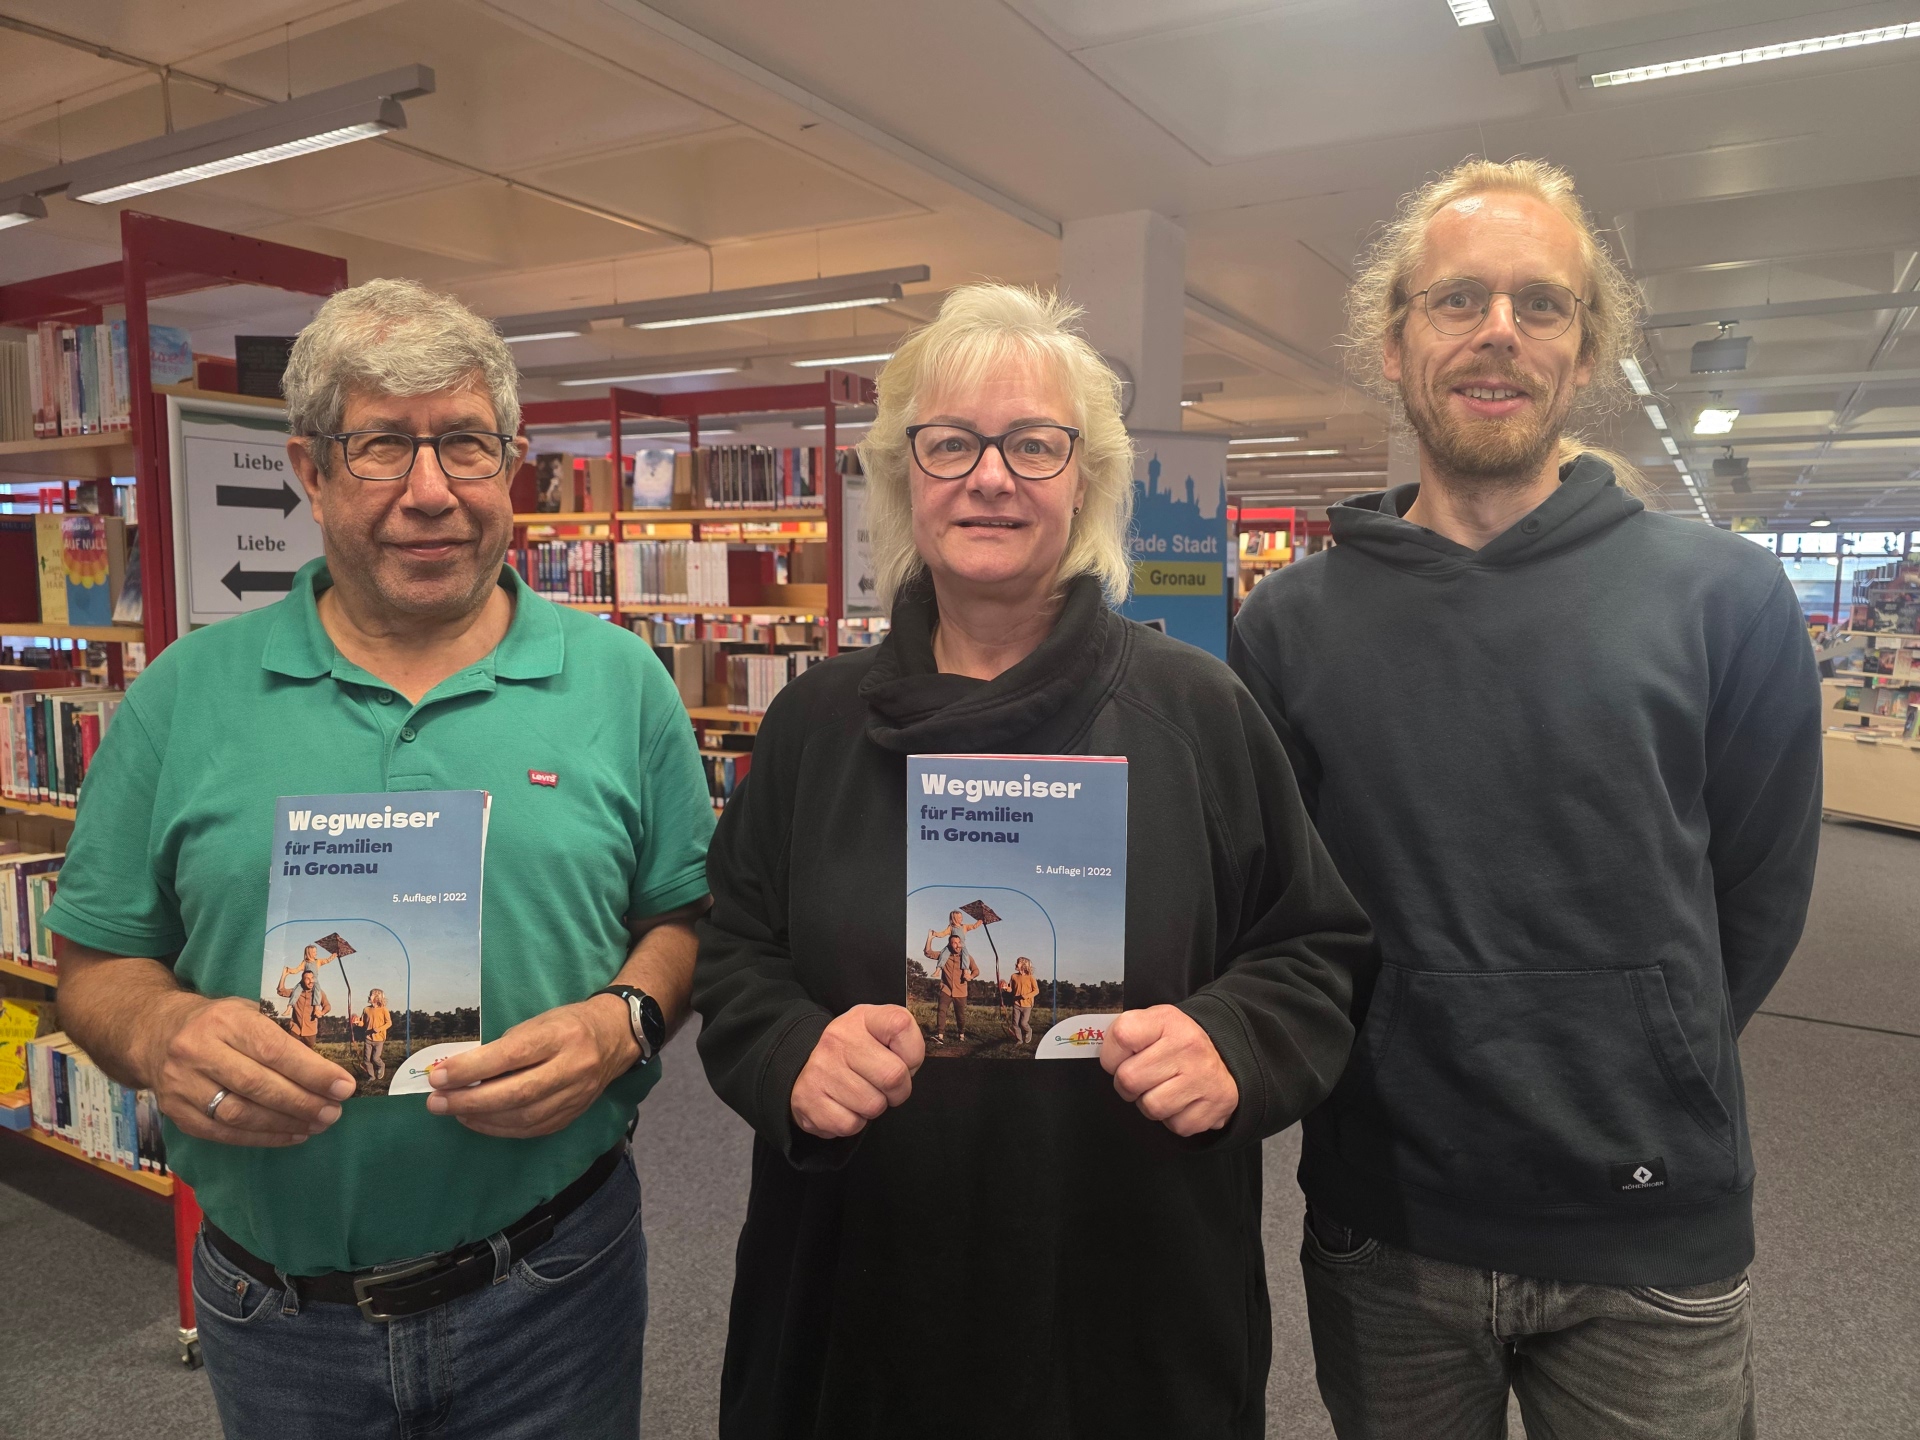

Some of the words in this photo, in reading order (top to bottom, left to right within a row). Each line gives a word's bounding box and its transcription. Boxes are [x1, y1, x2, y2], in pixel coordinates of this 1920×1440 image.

[841, 375, 850, 400] 1
[233, 452, 284, 471] Liebe
[82, 538, 107, 550] NULL
[237, 535, 286, 551] Liebe
[1171, 534, 1217, 554] Stadt
[1150, 569, 1206, 586] Gronau
[921, 773, 1081, 803] Wegweiser
[288, 805, 440, 836] Wegweiser
[920, 804, 947, 820] für
[951, 806, 1034, 823] Familien
[920, 825, 939, 841] in
[944, 827, 1020, 843] Gronau
[284, 840, 310, 855] für
[313, 838, 393, 855] Familien
[283, 861, 300, 876] in
[304, 861, 378, 875] Gronau
[1035, 865, 1044, 874] 5.
[1046, 865, 1081, 876] Auflage
[1087, 867, 1112, 876] 2022
[392, 894, 401, 902] 5.
[402, 893, 437, 903] Auflage
[443, 892, 467, 901] 2022
